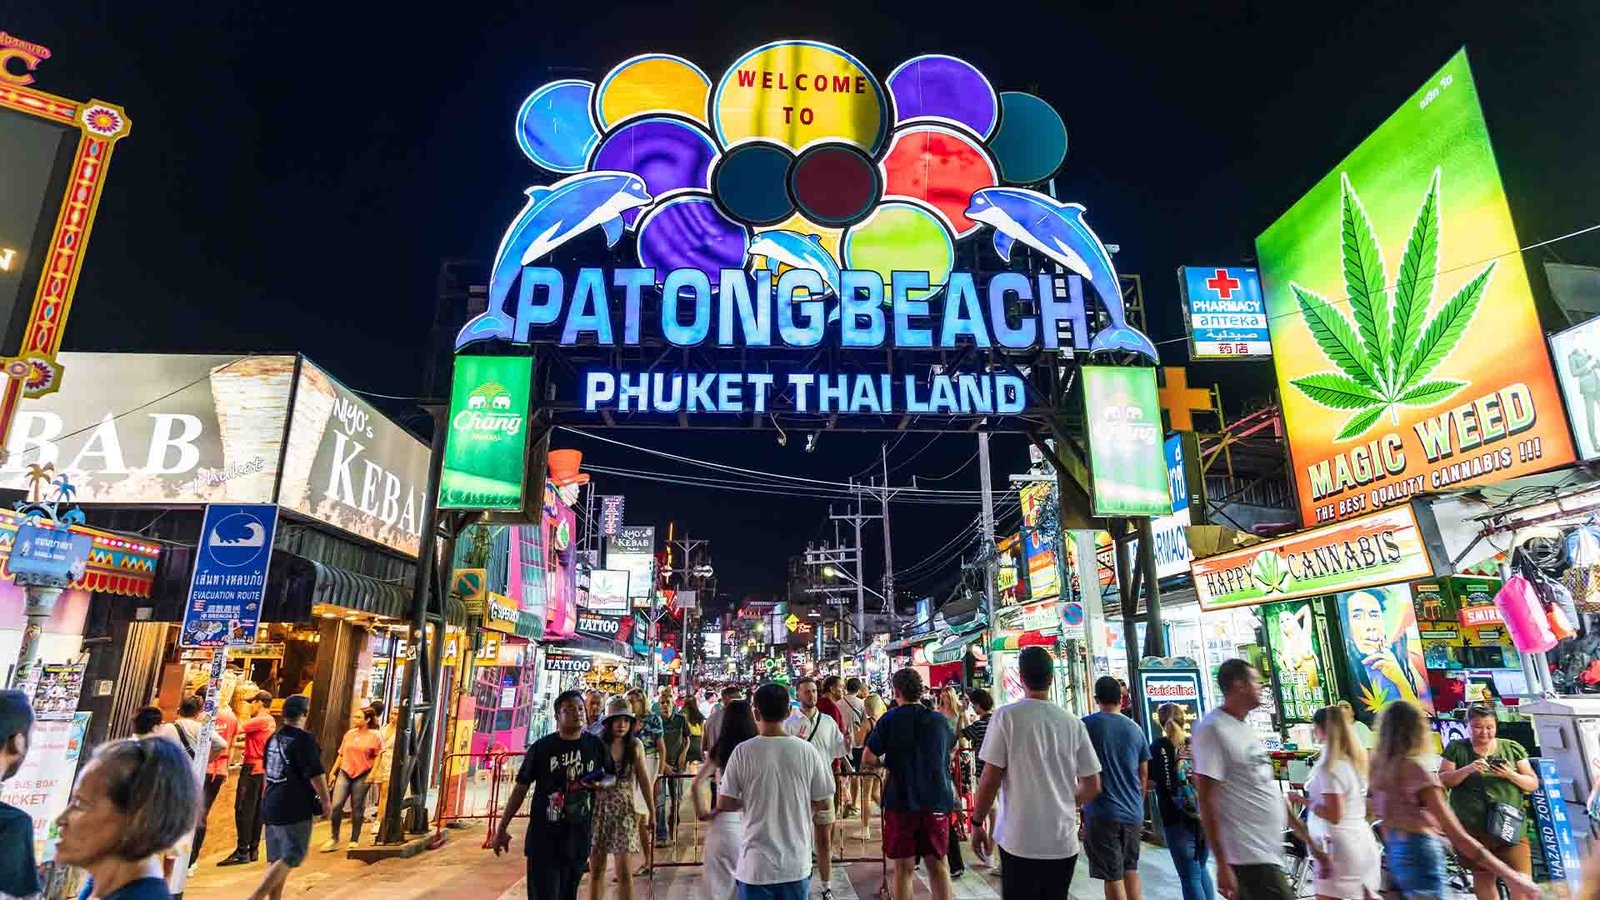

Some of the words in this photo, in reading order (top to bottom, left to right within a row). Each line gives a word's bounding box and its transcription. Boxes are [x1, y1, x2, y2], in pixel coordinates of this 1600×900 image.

[738, 69, 866, 94] WELCOME
[783, 106, 814, 125] TO
[513, 267, 827, 348] PATONG
[841, 269, 1091, 352] BEACH
[1193, 301, 1260, 312] PHARMACY
[1200, 316, 1259, 326] аптека
[1219, 343, 1248, 353] 药店
[585, 371, 774, 413] PHUKET
[453, 410, 523, 435] Chang
[1307, 433, 1407, 502] MAGIC
[1413, 382, 1537, 463] WEED
[1315, 507, 1336, 522] THE
[1339, 493, 1366, 516] BEST
[1371, 475, 1425, 506] QUALITY
[1431, 447, 1513, 488] CANNABIS
[618, 539, 649, 547] KEBAB
[1206, 560, 1256, 597] HAPPY
[1287, 530, 1402, 581] CANNABIS
[195, 569, 263, 586] เส้นทางหลบภัย
[193, 591, 235, 600] EVACUATION
[237, 591, 260, 600] ROUTE
[579, 619, 619, 633] TATTOO
[547, 660, 591, 671] TATTOO
[1281, 671, 1308, 686] GET
[1147, 684, 1197, 697] Guideline
[1281, 686, 1325, 702] HIGH
[1534, 789, 1551, 822] ZONE
[1543, 826, 1565, 879] HAZARD
